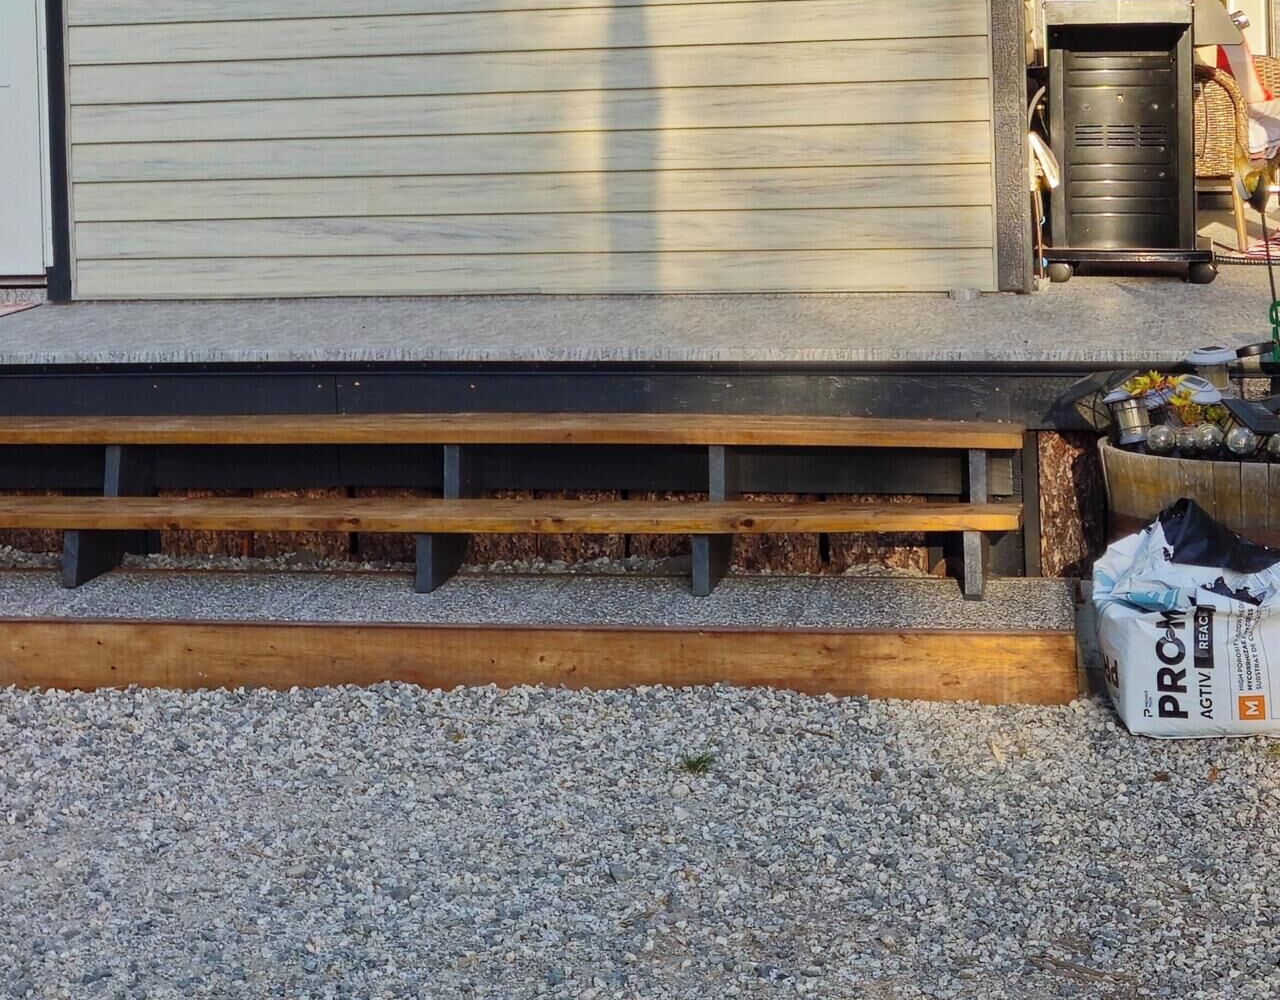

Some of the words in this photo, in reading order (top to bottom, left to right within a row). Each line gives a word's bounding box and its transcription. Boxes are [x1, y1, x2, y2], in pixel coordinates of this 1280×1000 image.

[1252, 654, 1262, 691] SUBSTRAT
[1198, 671, 1214, 720] AGTIV
[1245, 700, 1259, 716] M
